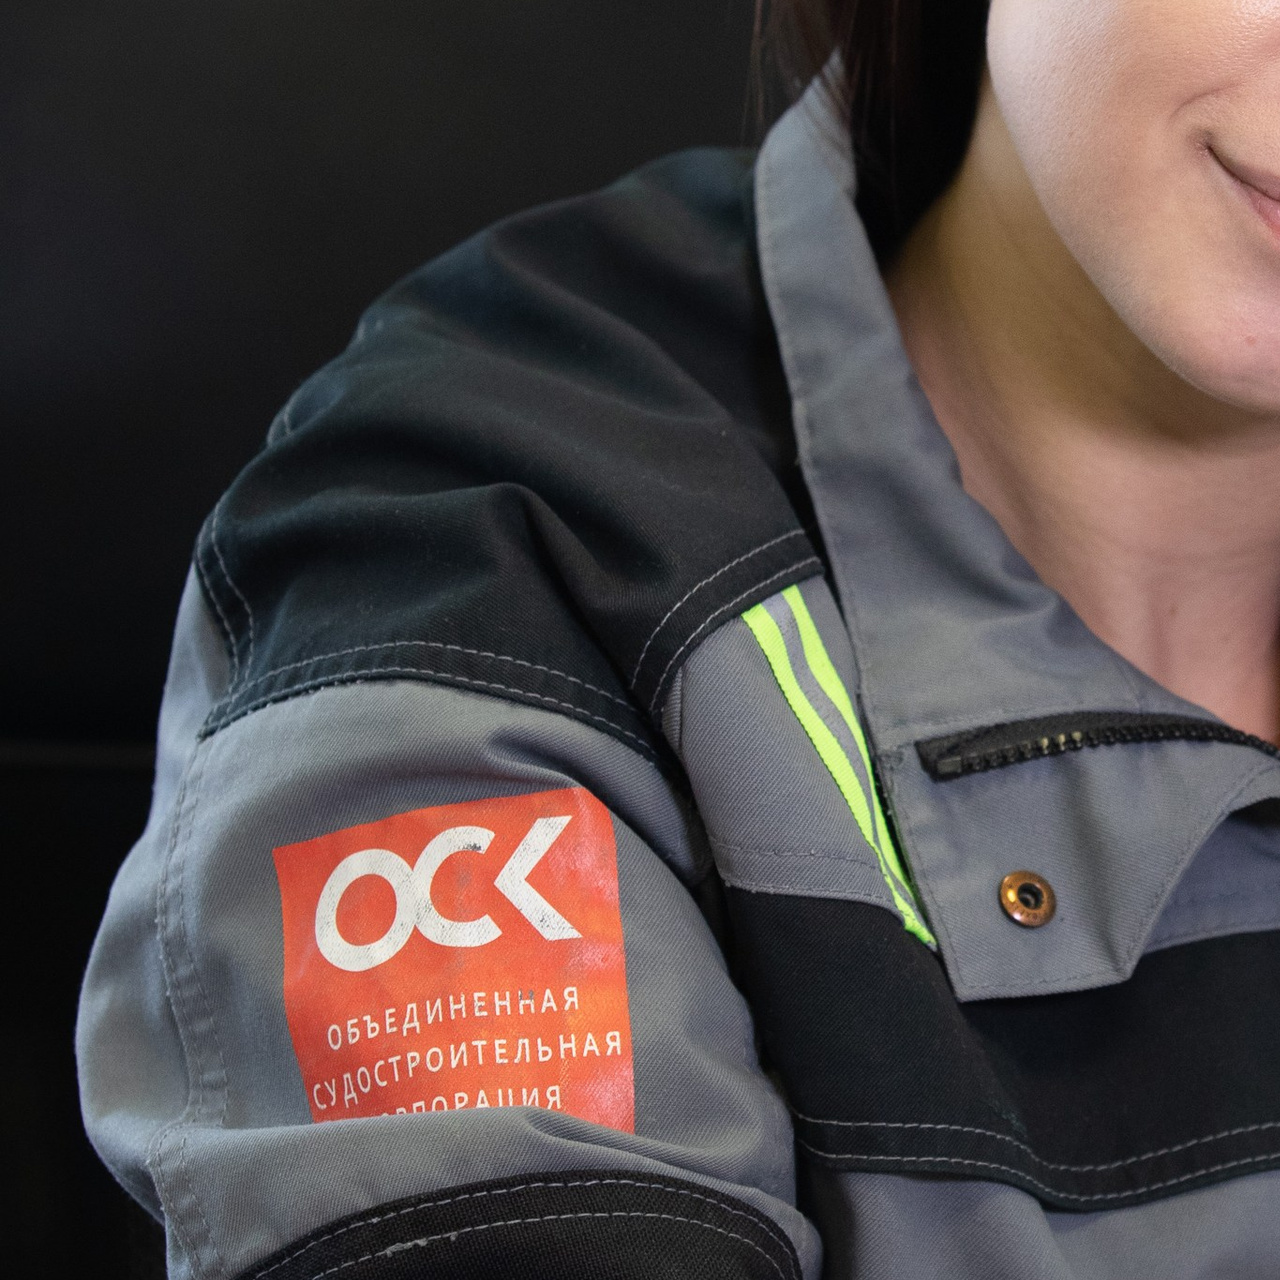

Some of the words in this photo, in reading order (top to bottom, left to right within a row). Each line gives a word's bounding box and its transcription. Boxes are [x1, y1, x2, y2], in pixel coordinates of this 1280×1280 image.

[315, 815, 583, 972] ОСК
[327, 986, 580, 1051] ОБЪЕДИНЕННАЯ
[312, 1030, 622, 1111] СУДОСТРОИТЕЛЬНАЯ
